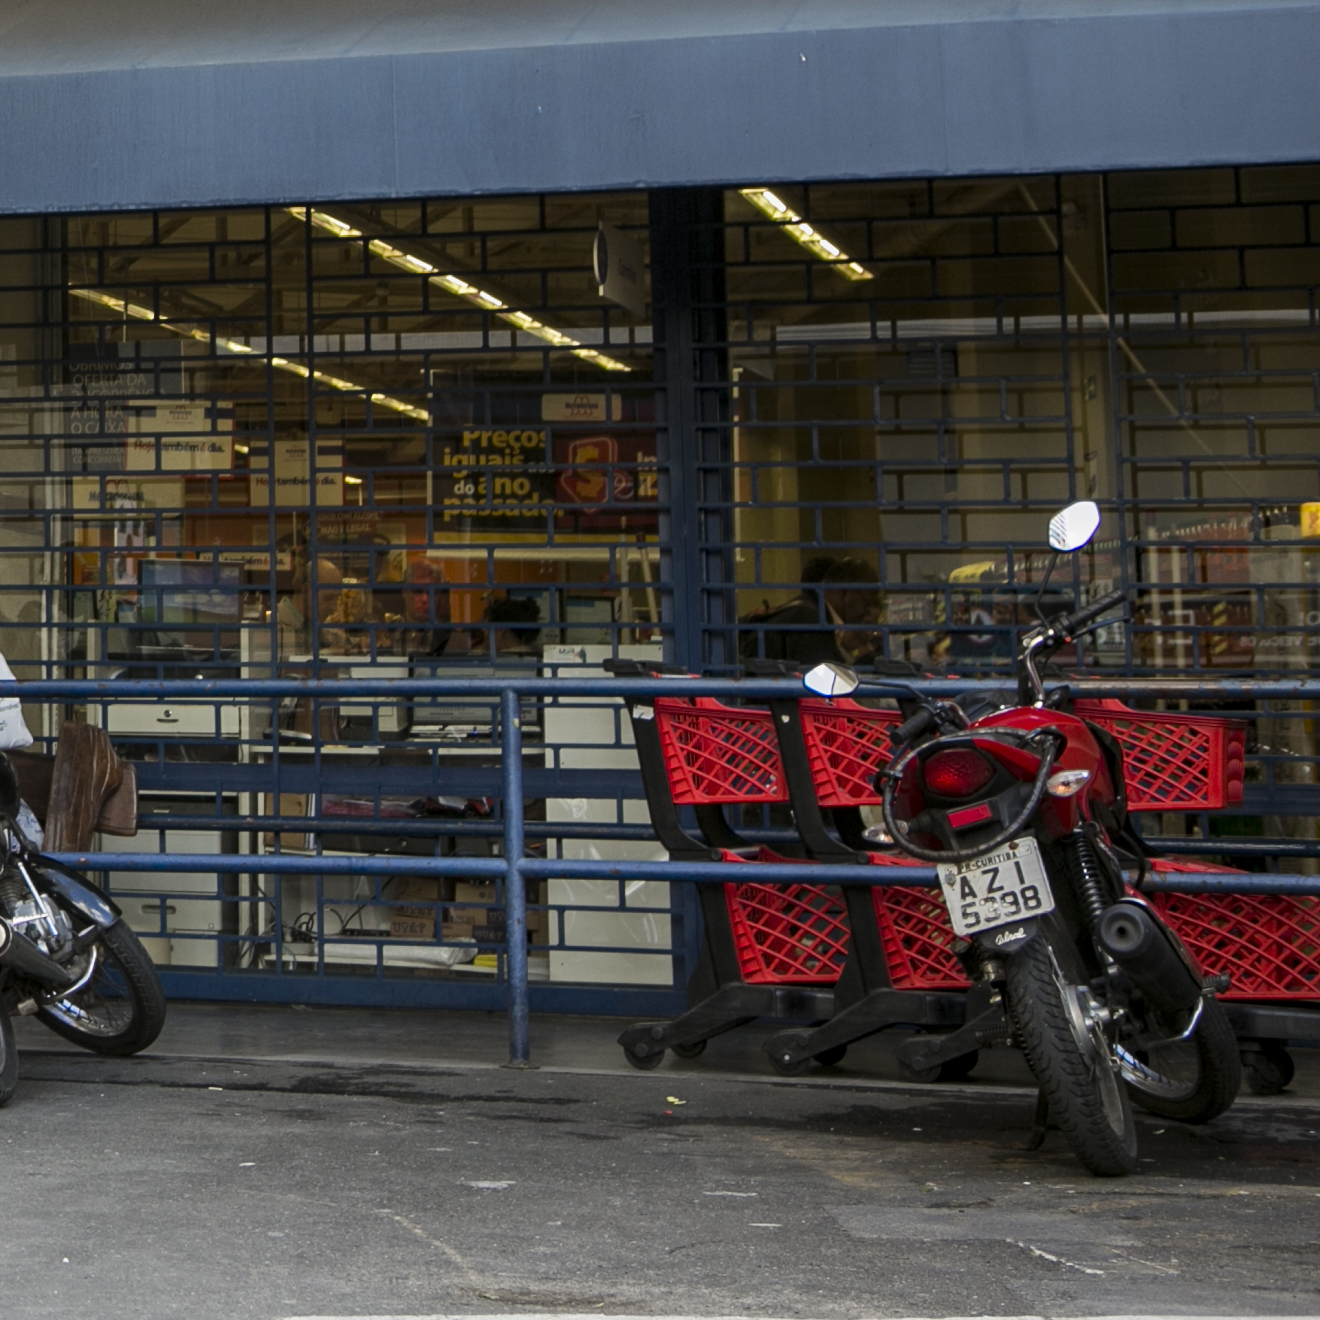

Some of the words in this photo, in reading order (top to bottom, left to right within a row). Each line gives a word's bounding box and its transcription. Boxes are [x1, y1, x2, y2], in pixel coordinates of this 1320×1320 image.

[73, 373, 124, 387] OFERTA
[126, 372, 147, 386] DA
[161, 441, 199, 452] ambém
[207, 443, 225, 453] dia.
[454, 480, 475, 495] do
[477, 476, 531, 495] ano
[961, 884, 1043, 928] 5398
